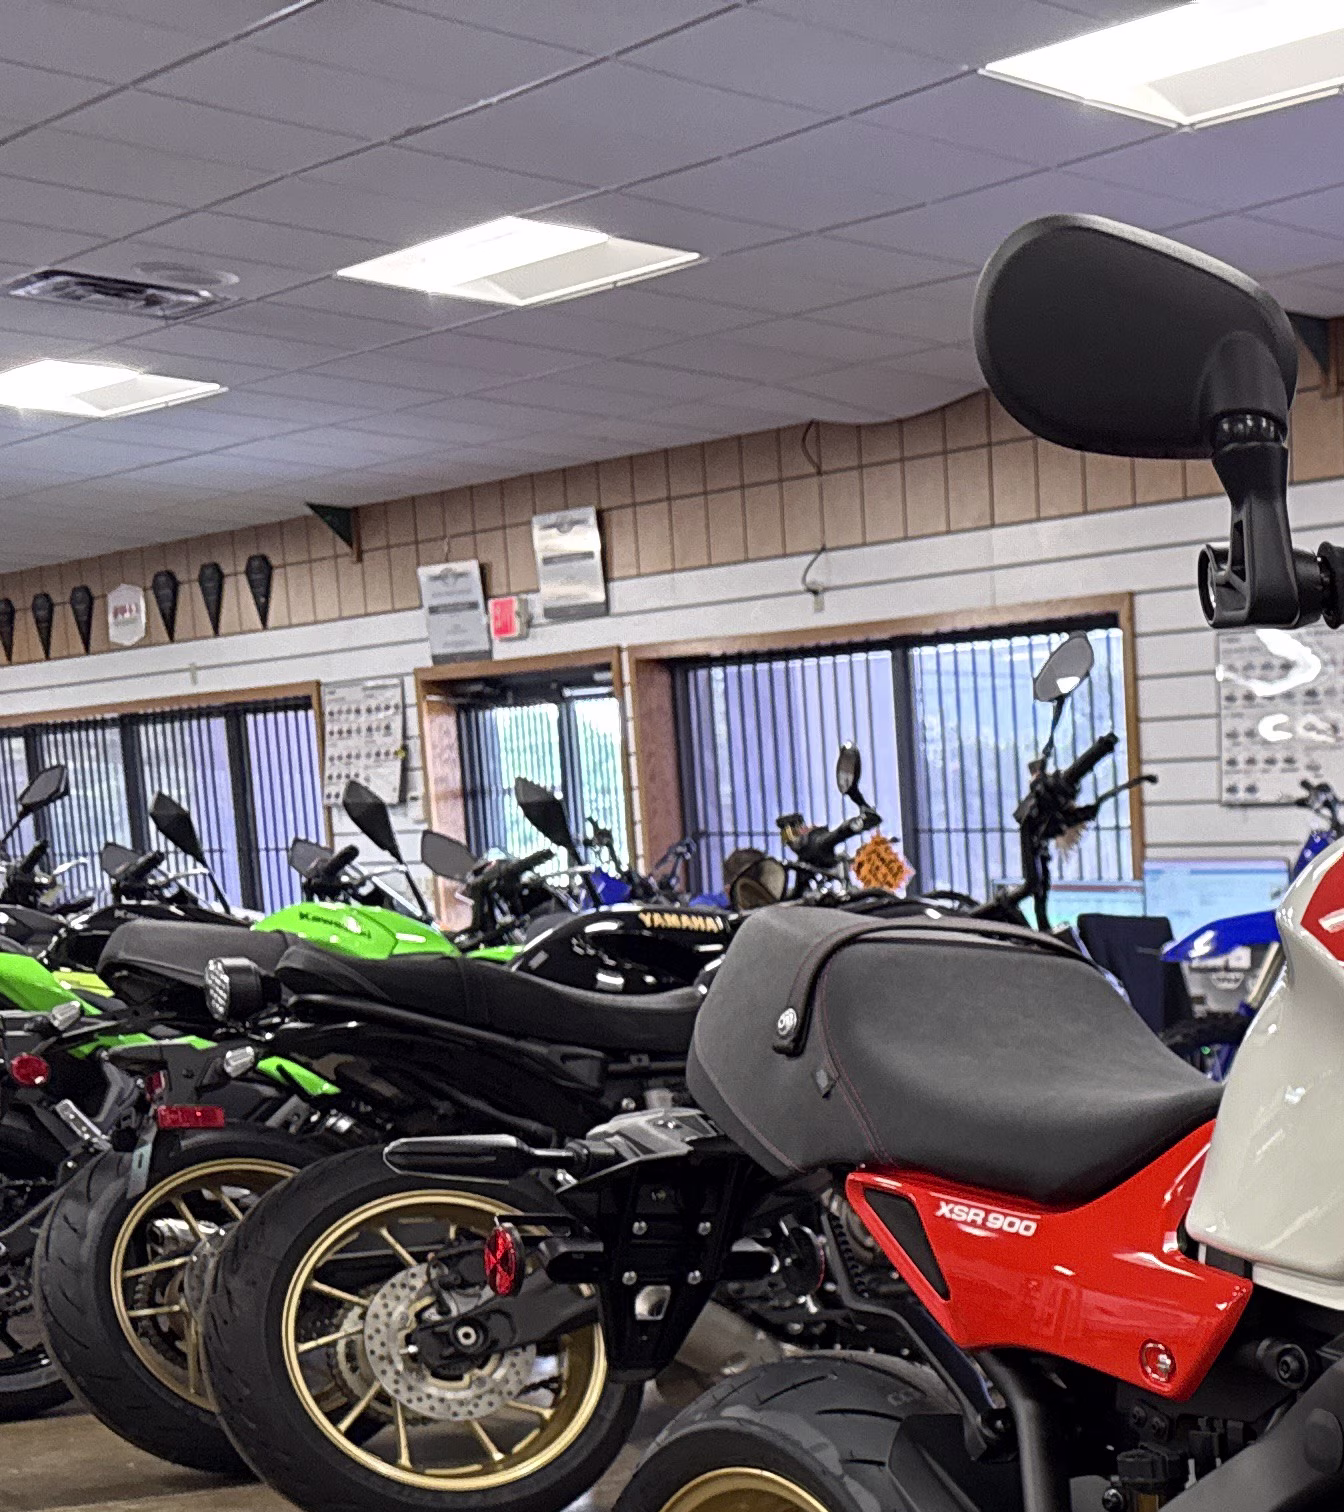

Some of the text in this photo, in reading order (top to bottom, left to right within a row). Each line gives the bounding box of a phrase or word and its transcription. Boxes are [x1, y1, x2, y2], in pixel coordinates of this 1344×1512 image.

[638, 911, 719, 934] YAMAHA
[935, 1199, 1037, 1238] XSR 900
